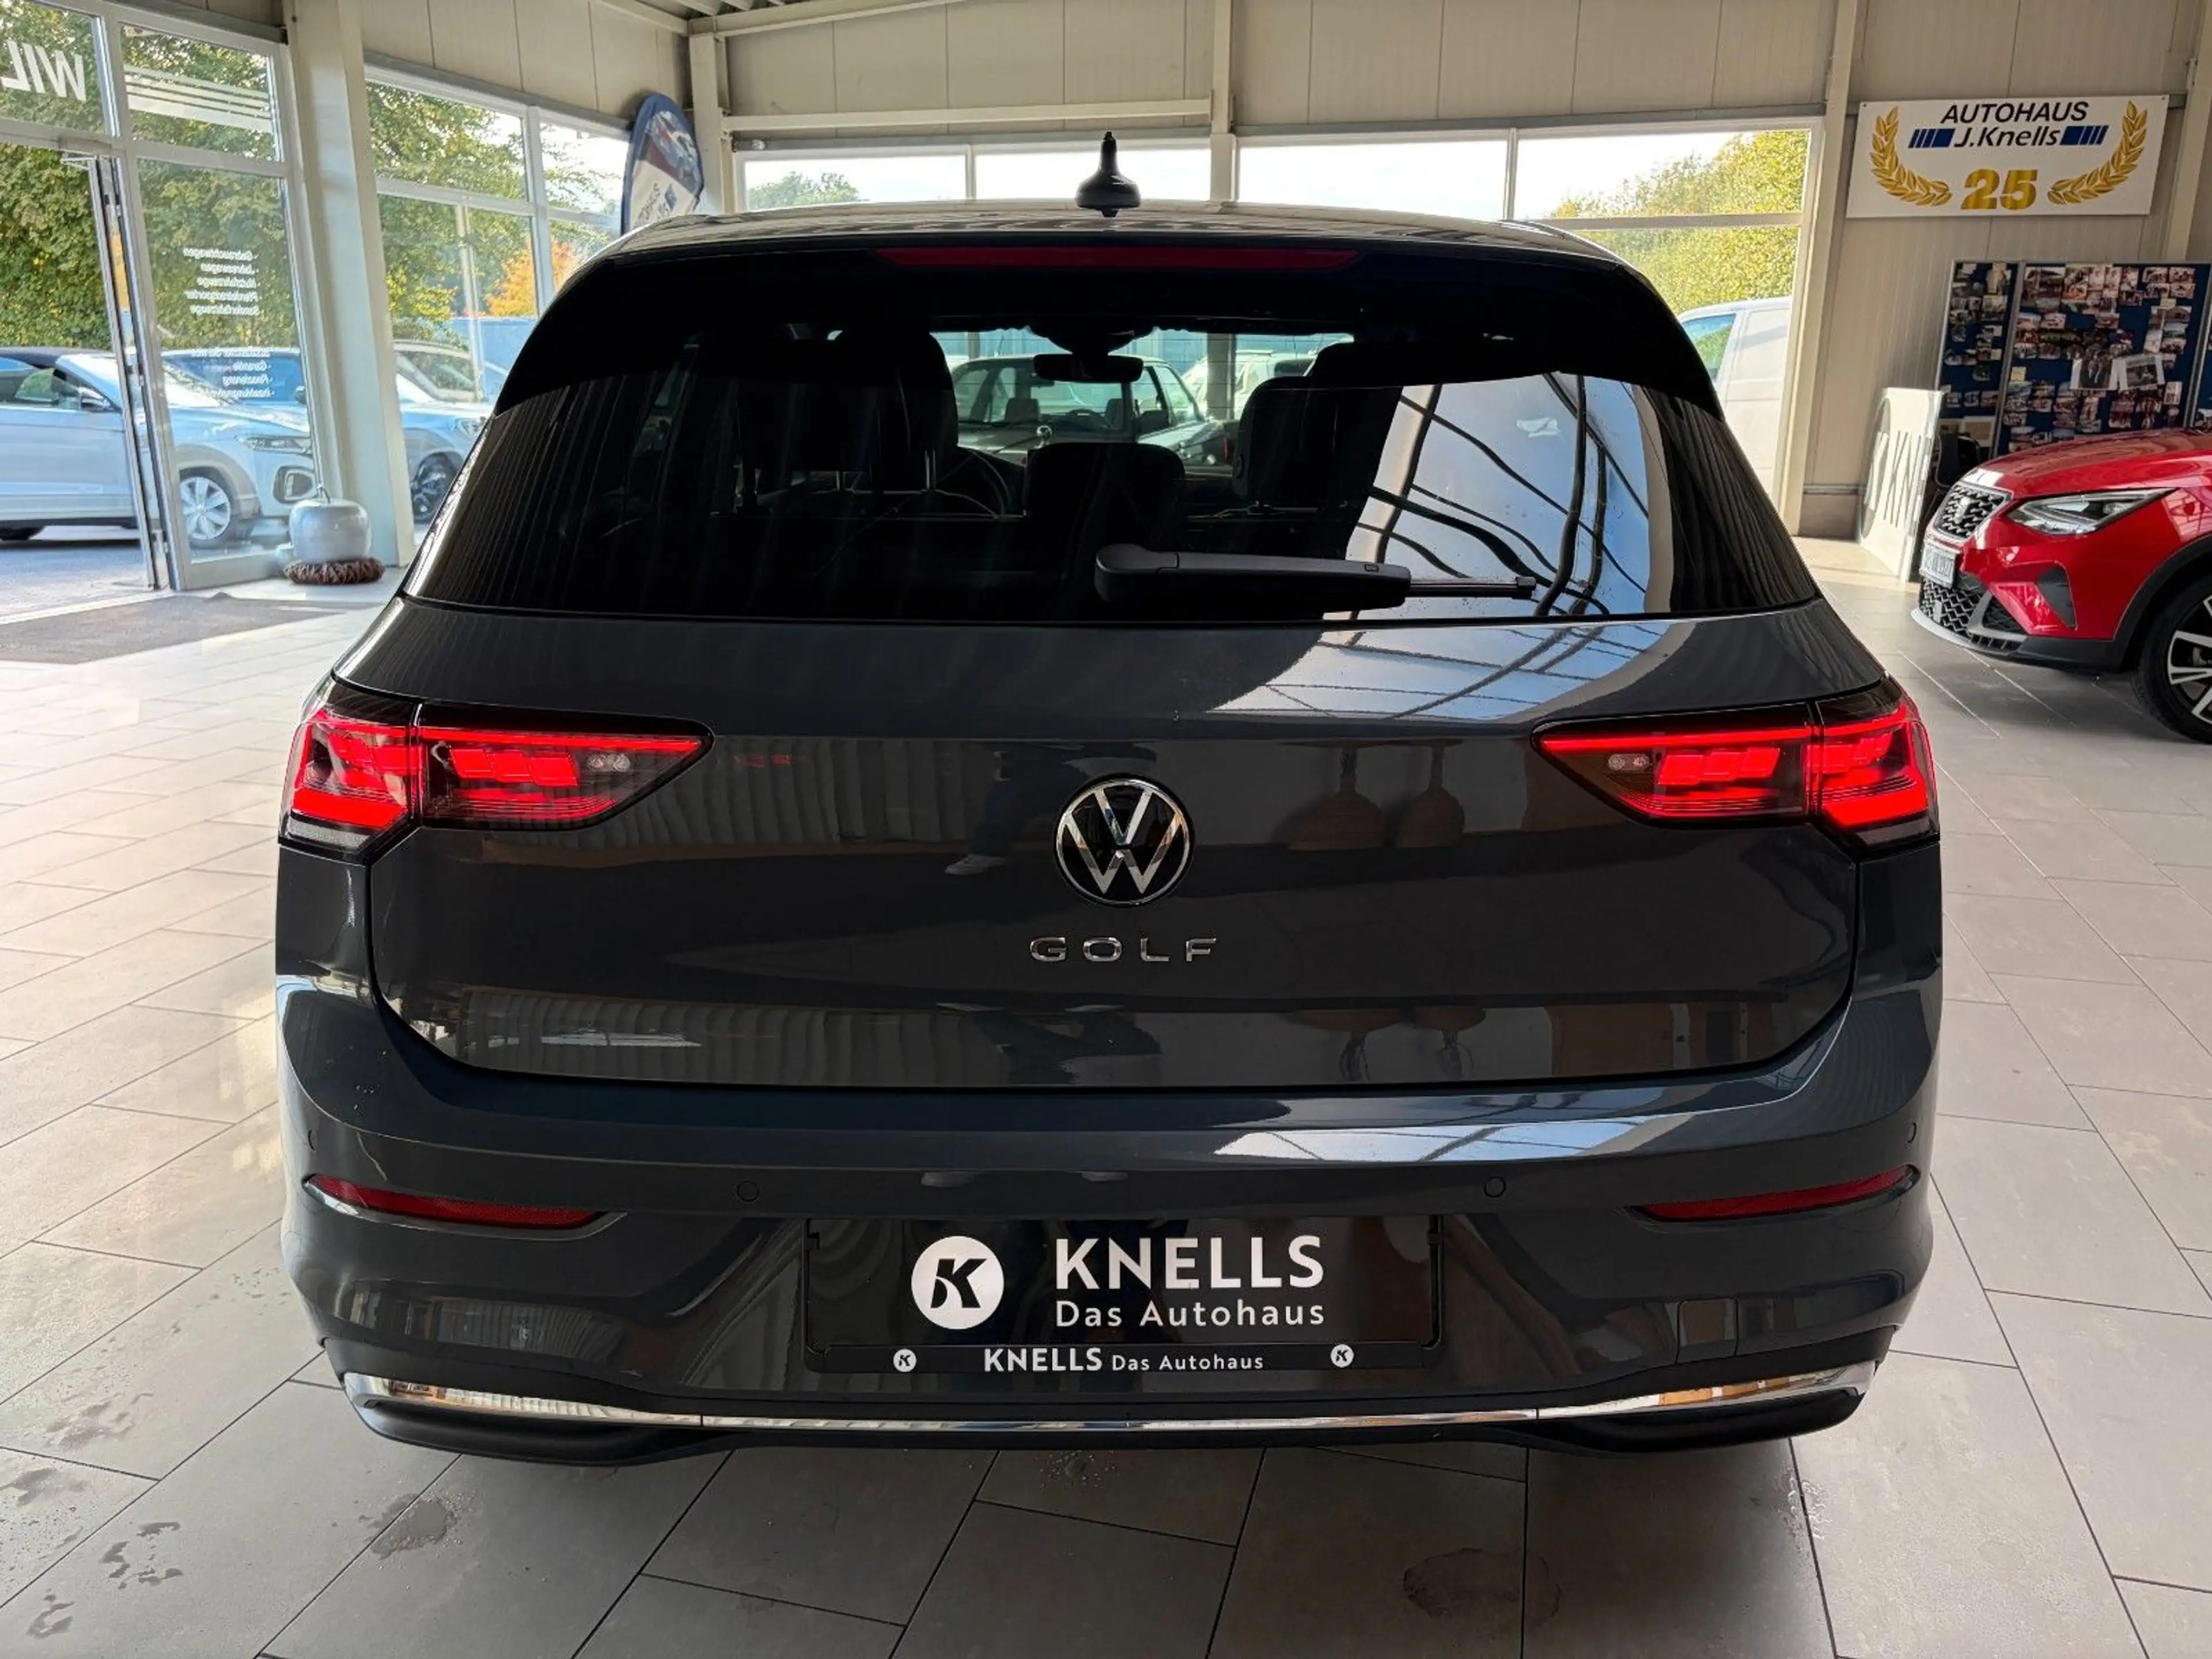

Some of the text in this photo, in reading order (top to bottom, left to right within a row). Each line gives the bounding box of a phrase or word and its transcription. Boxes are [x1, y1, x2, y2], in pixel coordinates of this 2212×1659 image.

[1940, 101, 2089, 124] AUTOHAUS
[1953, 125, 2061, 148] J.Knells
[1960, 168, 2038, 211] 25
[1029, 937, 1217, 962] GOLF
[1056, 1234, 1324, 1289] KNELLS
[1056, 1298, 1325, 1327] Das Autohaus
[984, 1347, 1264, 1372] KNELLS Das Autohaus
